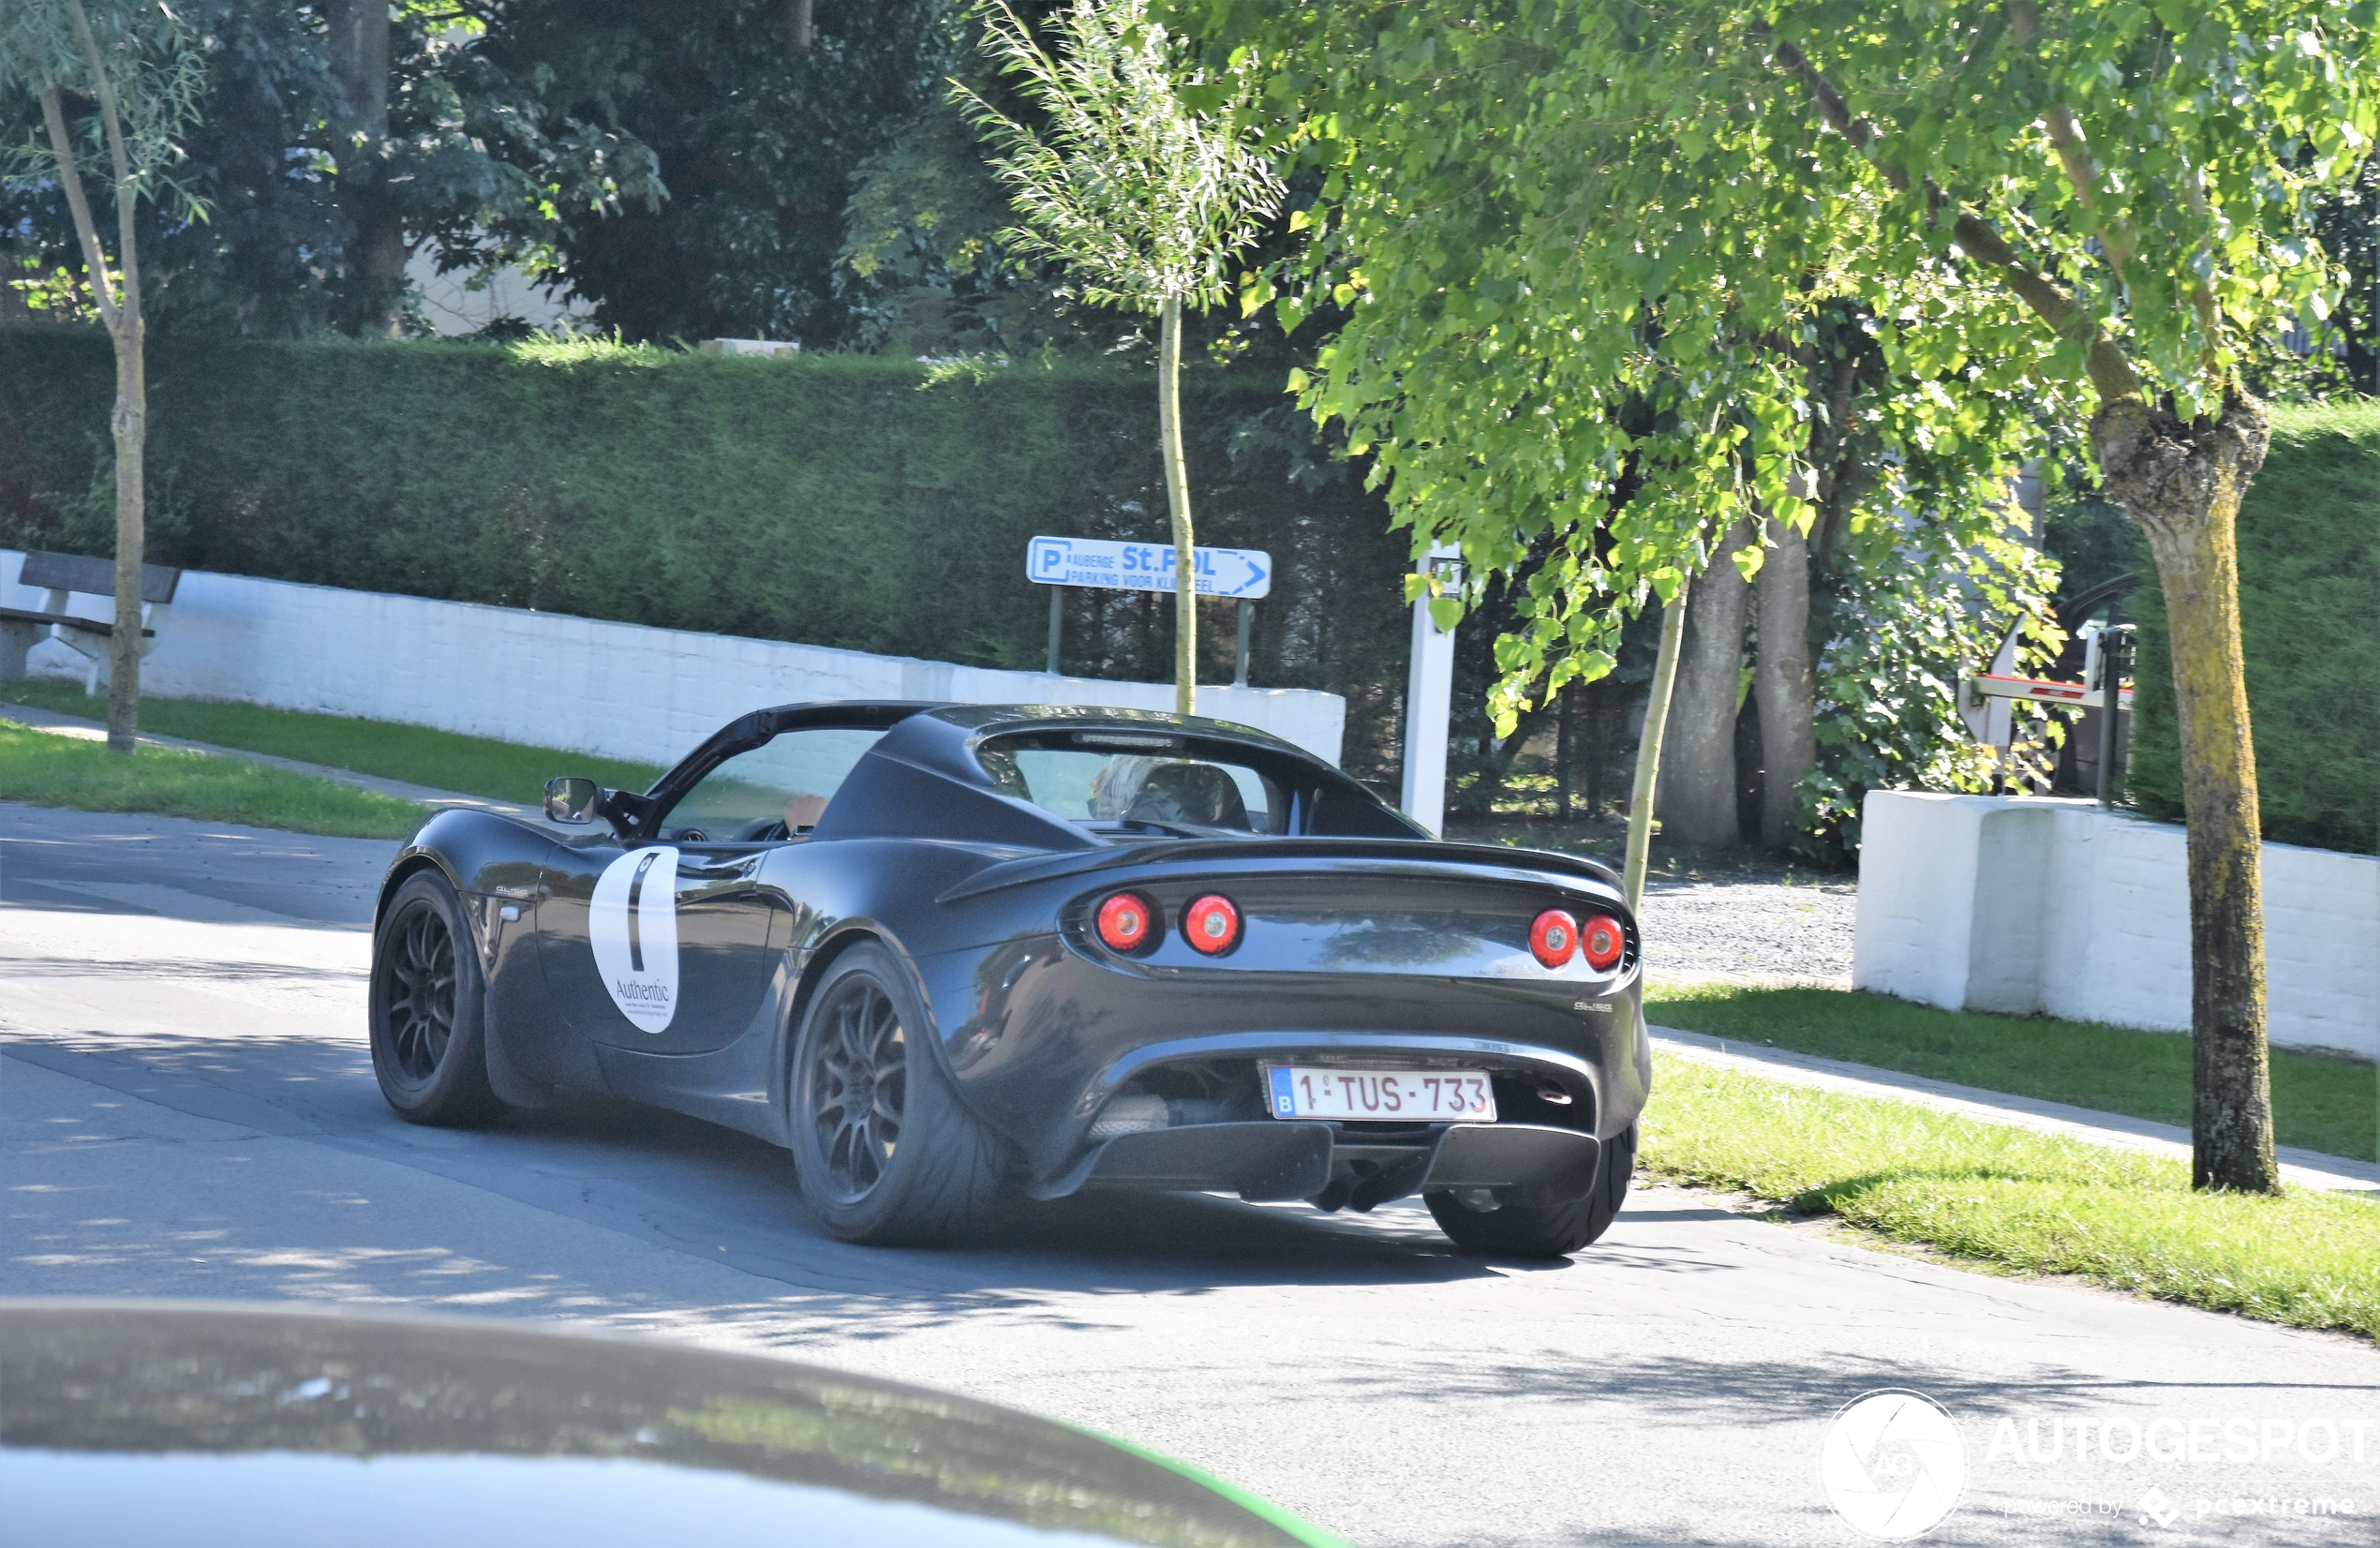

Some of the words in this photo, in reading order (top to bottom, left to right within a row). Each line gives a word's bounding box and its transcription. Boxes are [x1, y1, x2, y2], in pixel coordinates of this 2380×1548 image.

[1043, 549, 1061, 573] P
[1071, 554, 1114, 569] AUBERGE
[1070, 571, 1119, 587] PARKING
[1123, 574, 1153, 588] VOOR
[617, 978, 669, 1002] Authentic
[1278, 1095, 1293, 1113] B
[1301, 1075, 1487, 1113] 1-TUS-733
